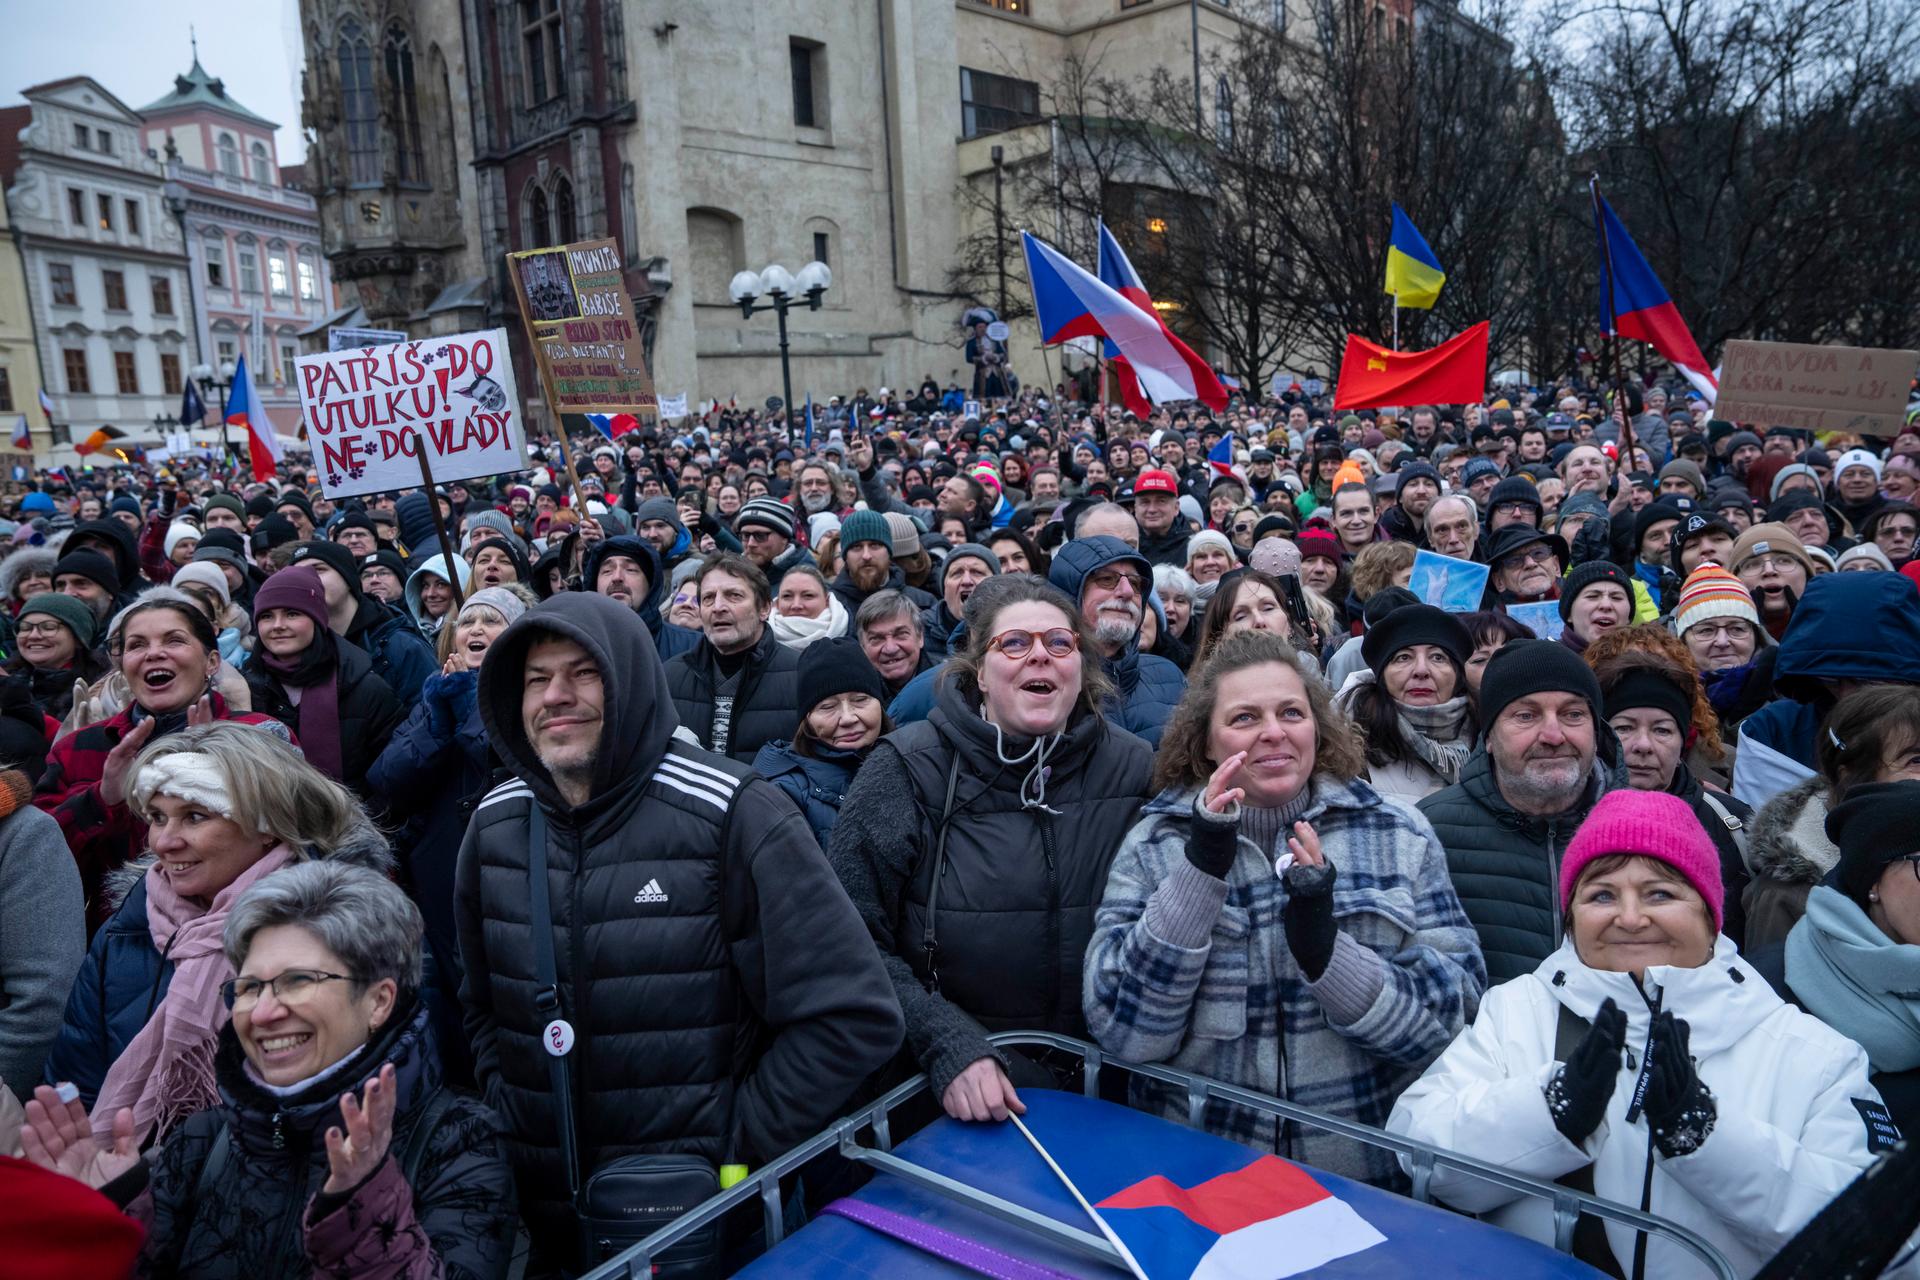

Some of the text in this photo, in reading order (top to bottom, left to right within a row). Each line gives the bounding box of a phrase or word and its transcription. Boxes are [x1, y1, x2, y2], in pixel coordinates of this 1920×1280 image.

[569, 247, 620, 276] IMUNITA
[580, 289, 623, 316] BABIŠE
[300, 339, 493, 399] PATŘÍŠ DO
[1727, 344, 1873, 373] PRAVDA A
[1724, 371, 1783, 393] LÁSKA
[309, 367, 452, 436] ÚTULKU!
[322, 406, 512, 474] NE DO VLÁDY
[634, 894, 669, 903] adidas
[1634, 1071, 1650, 1106] APPAREL
